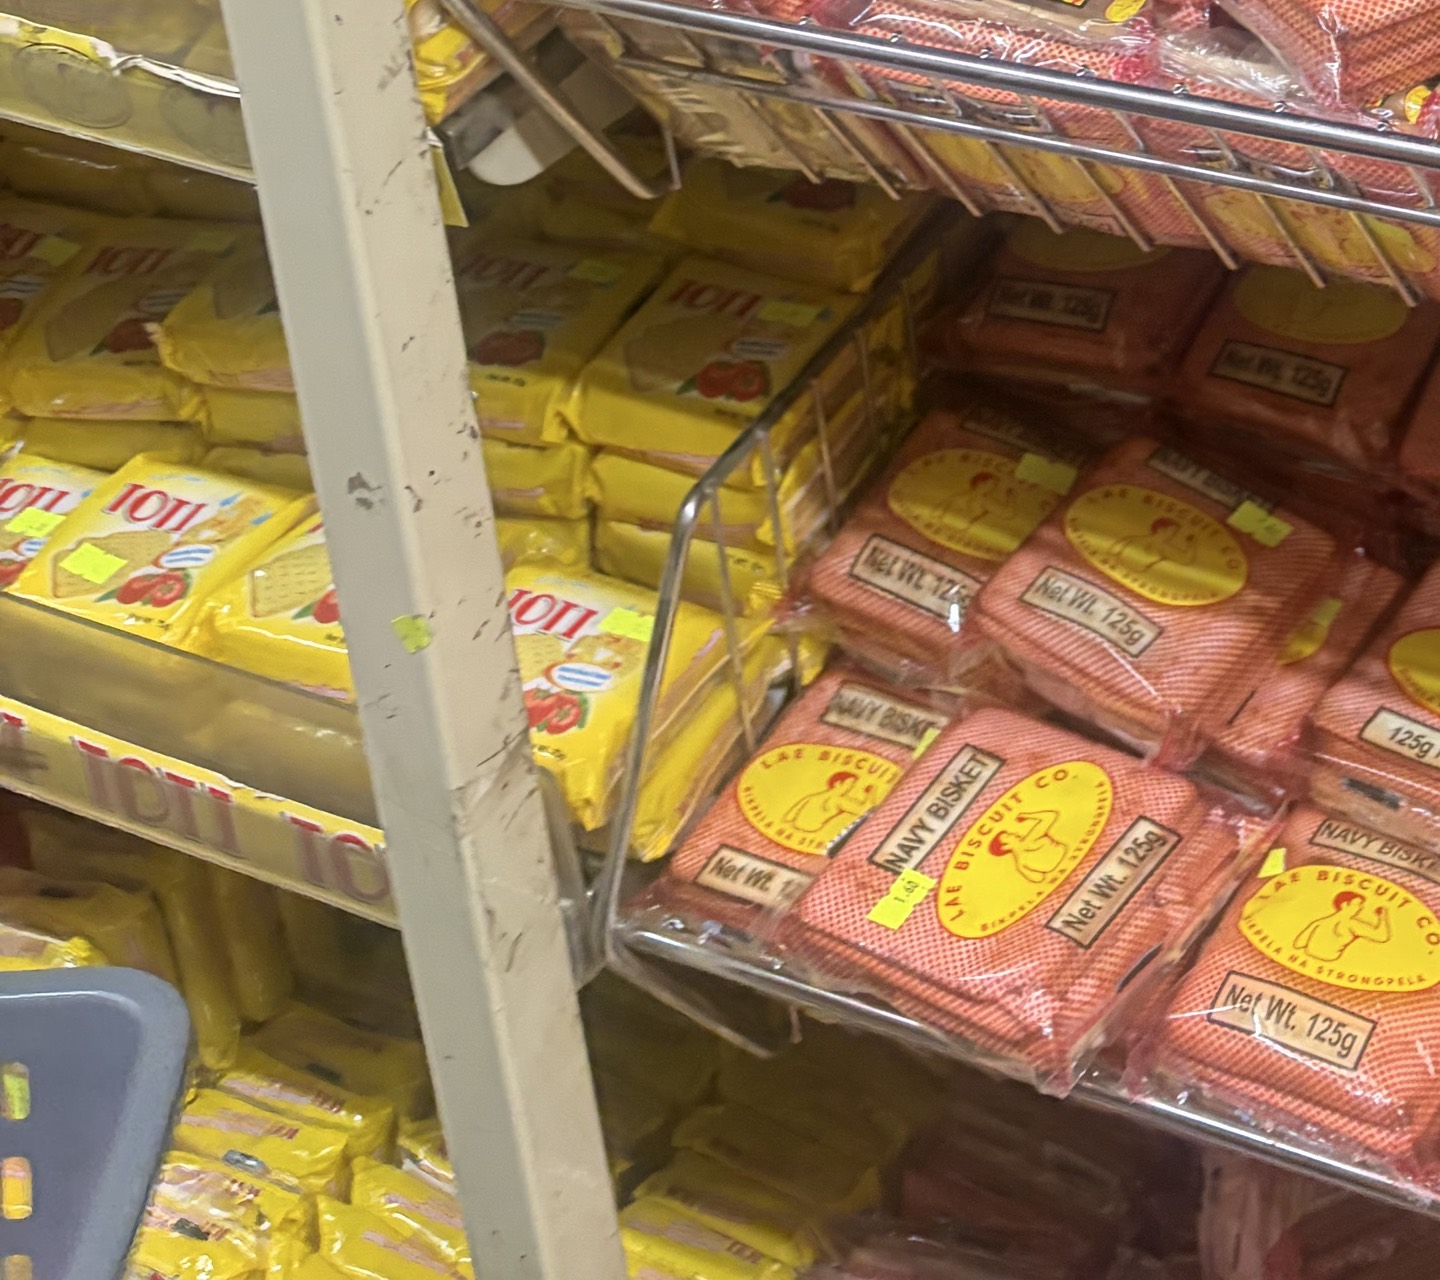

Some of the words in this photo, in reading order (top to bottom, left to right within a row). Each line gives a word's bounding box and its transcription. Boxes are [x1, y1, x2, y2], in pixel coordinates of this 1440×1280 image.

[864, 548, 899, 574] Net
[1037, 578, 1073, 603] Net
[1071, 587, 1099, 617] Wt.
[1104, 606, 1148, 646] 125g
[761, 748, 805, 770] LAE
[1388, 724, 1434, 759] 125g
[881, 817, 941, 873] NAVY
[927, 754, 990, 821] BISKET
[711, 854, 746, 879] Net
[743, 865, 773, 891] Wt.
[1061, 901, 1103, 939] Net
[1089, 864, 1129, 916] Wt.
[1117, 827, 1166, 871] 125g
[1257, 871, 1301, 901] LAE
[1316, 868, 1413, 911] BISCUIT
[1285, 955, 1309, 970] NA
[1312, 965, 1428, 989] STRONGPELA
[1226, 984, 1263, 1014] Net
[1262, 997, 1297, 1030] Wt.
[1307, 1012, 1358, 1059] 125g
